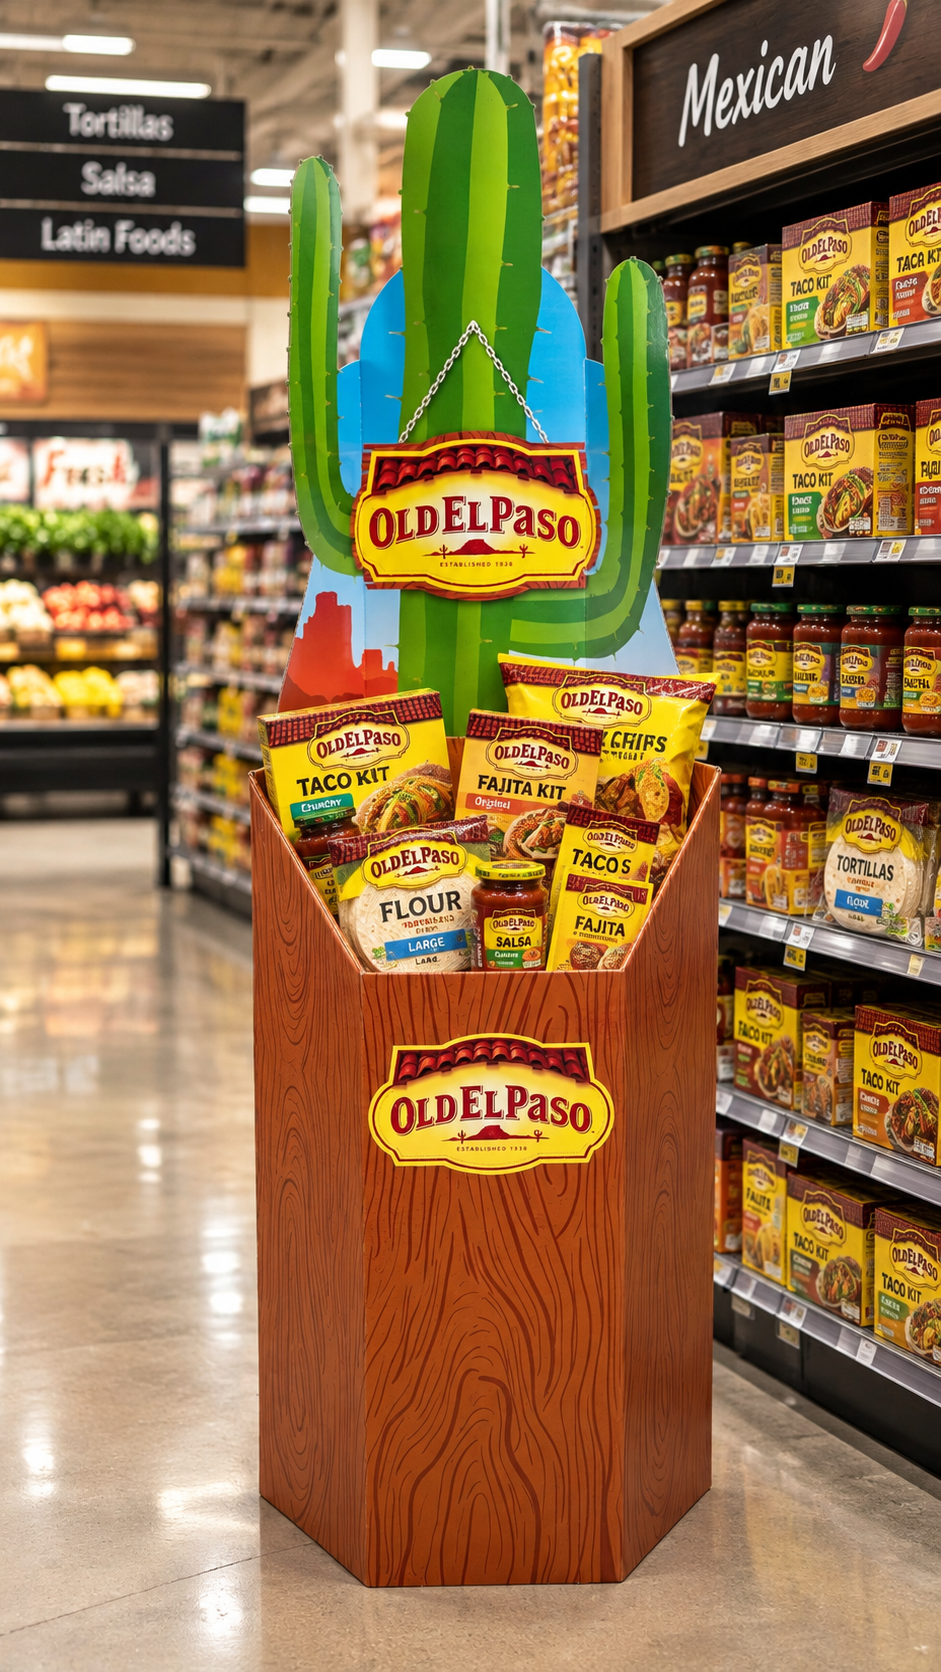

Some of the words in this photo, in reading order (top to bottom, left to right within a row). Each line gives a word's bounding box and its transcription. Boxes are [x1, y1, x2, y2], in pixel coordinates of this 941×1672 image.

[678, 34, 836, 147] Mexican
[62, 102, 174, 141] Tortillas
[81, 161, 156, 197] Salsa
[40, 216, 111, 253] Latin
[114, 219, 197, 257] Foods
[790, 277, 814, 297] TACO
[816, 274, 832, 290] KIT
[792, 472, 816, 489] TACO
[818, 472, 834, 487] KIT
[296, 772, 352, 796] TACO
[356, 766, 390, 786] KIT
[477, 774, 532, 795] FAJITA
[537, 783, 566, 800] KIT
[572, 848, 632, 875] TACOS
[837, 854, 894, 881] TORTILLAS
[379, 890, 462, 923] FLOUR
[575, 915, 625, 938] FAJITA
[408, 936, 446, 952] LARGE
[496, 936, 531, 948] SALSA
[861, 1067, 884, 1090] TACO
[885, 1078, 900, 1096] KIT
[794, 1232, 814, 1254] TACO
[881, 1272, 906, 1297] TACO
[907, 1286, 922, 1304] KIT
